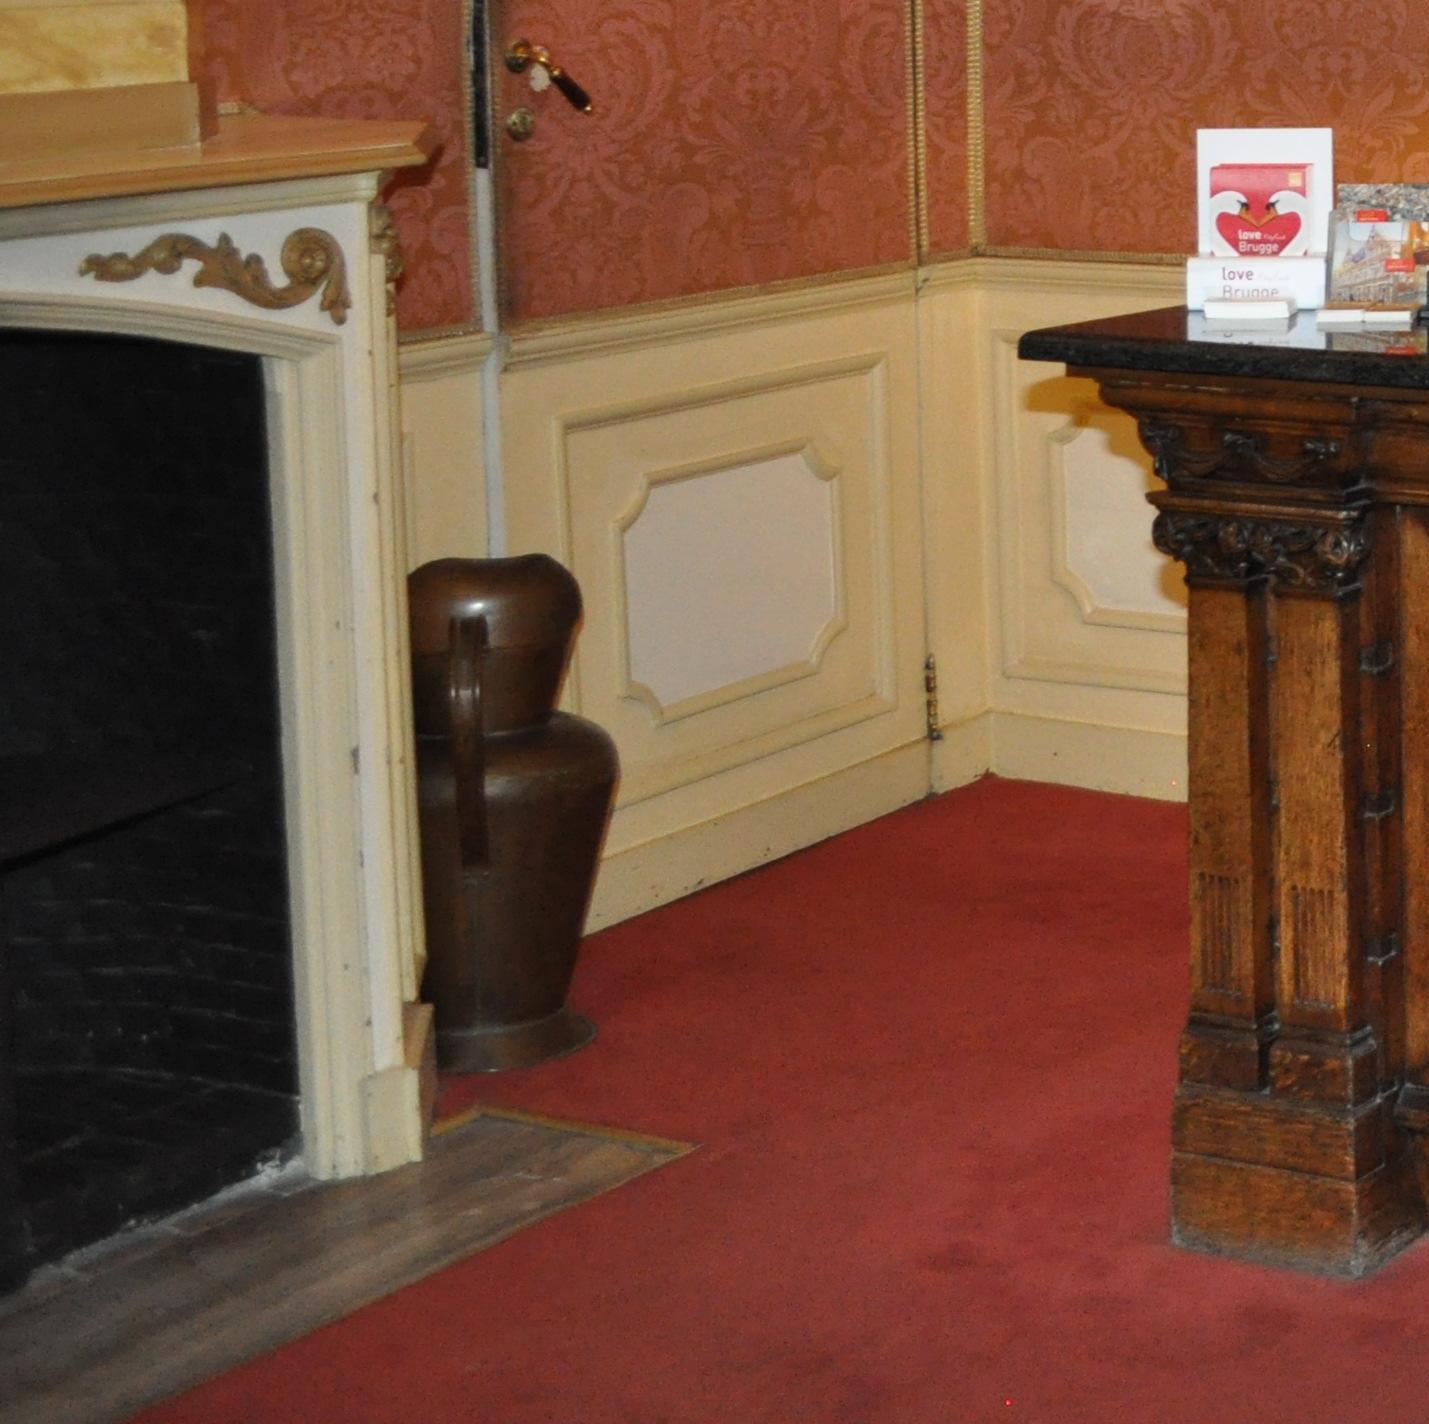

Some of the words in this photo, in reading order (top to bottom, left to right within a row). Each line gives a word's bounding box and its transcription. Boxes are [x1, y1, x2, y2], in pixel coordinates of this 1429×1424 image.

[1238, 229, 1262, 240] love
[1238, 241, 1280, 255] Brugge
[1222, 266, 1254, 281] love
